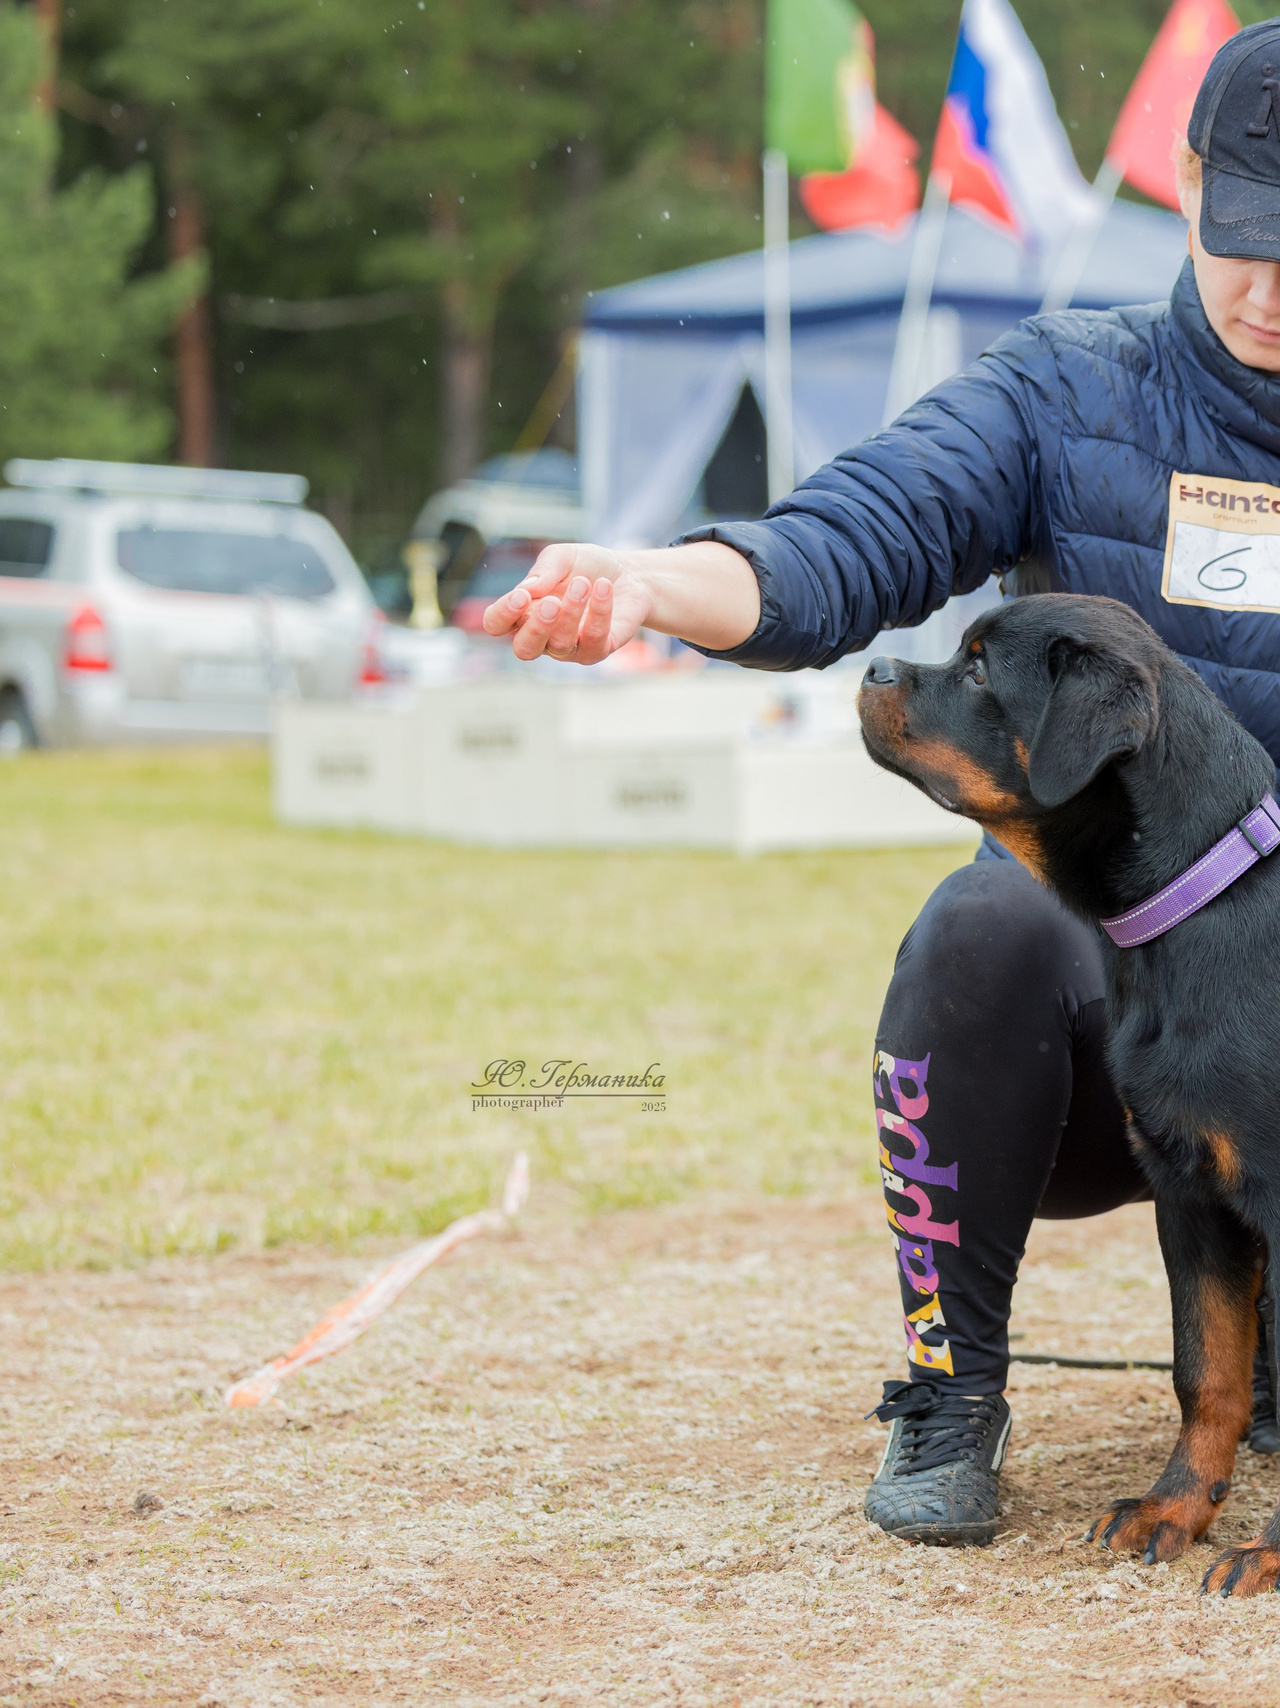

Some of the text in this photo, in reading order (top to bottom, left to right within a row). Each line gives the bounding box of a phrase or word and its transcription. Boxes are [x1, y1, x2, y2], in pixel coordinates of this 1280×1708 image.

[1238, 227, 1280, 243] New
[1212, 512, 1258, 525] premium
[1197, 546, 1252, 592] 6
